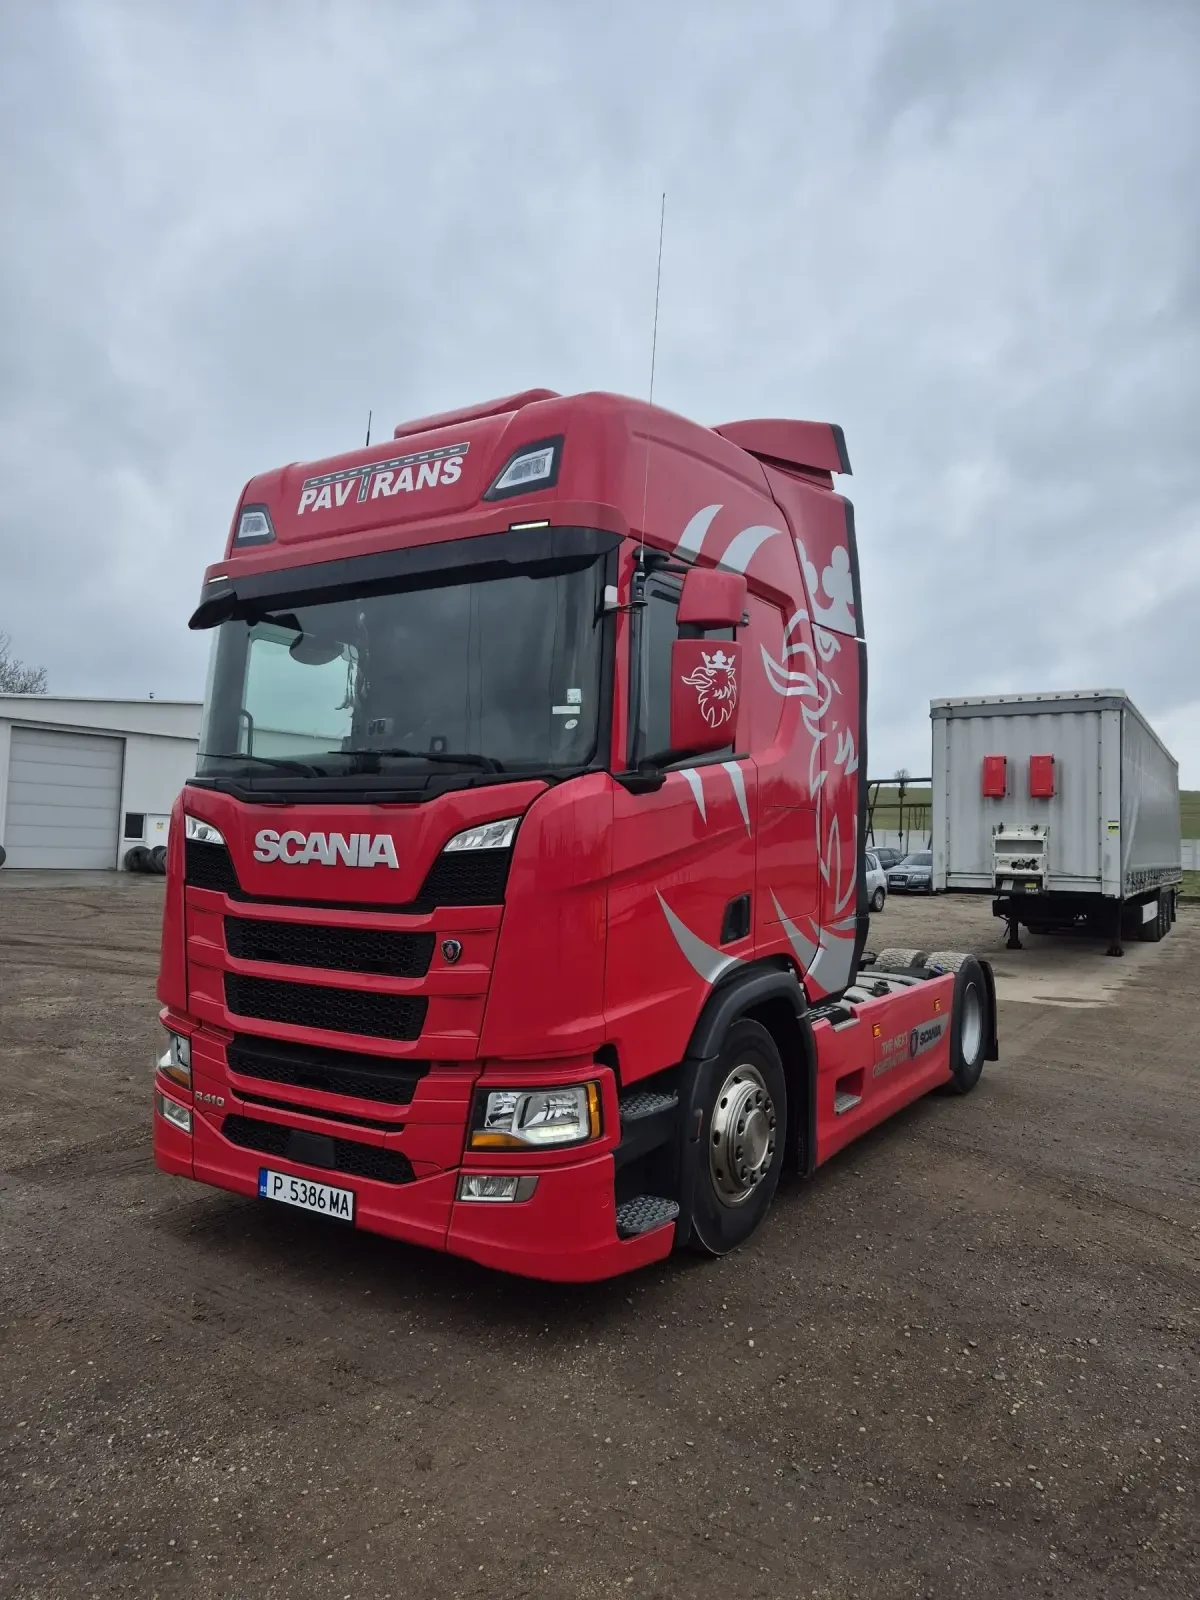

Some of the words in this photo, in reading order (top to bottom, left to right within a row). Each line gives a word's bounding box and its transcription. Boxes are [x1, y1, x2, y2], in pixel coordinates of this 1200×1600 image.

[253, 829, 400, 868] SCANIA
[919, 1025, 941, 1046] SCANIA
[290, 1180, 326, 1209] 5386
[329, 1190, 349, 1216] MA
